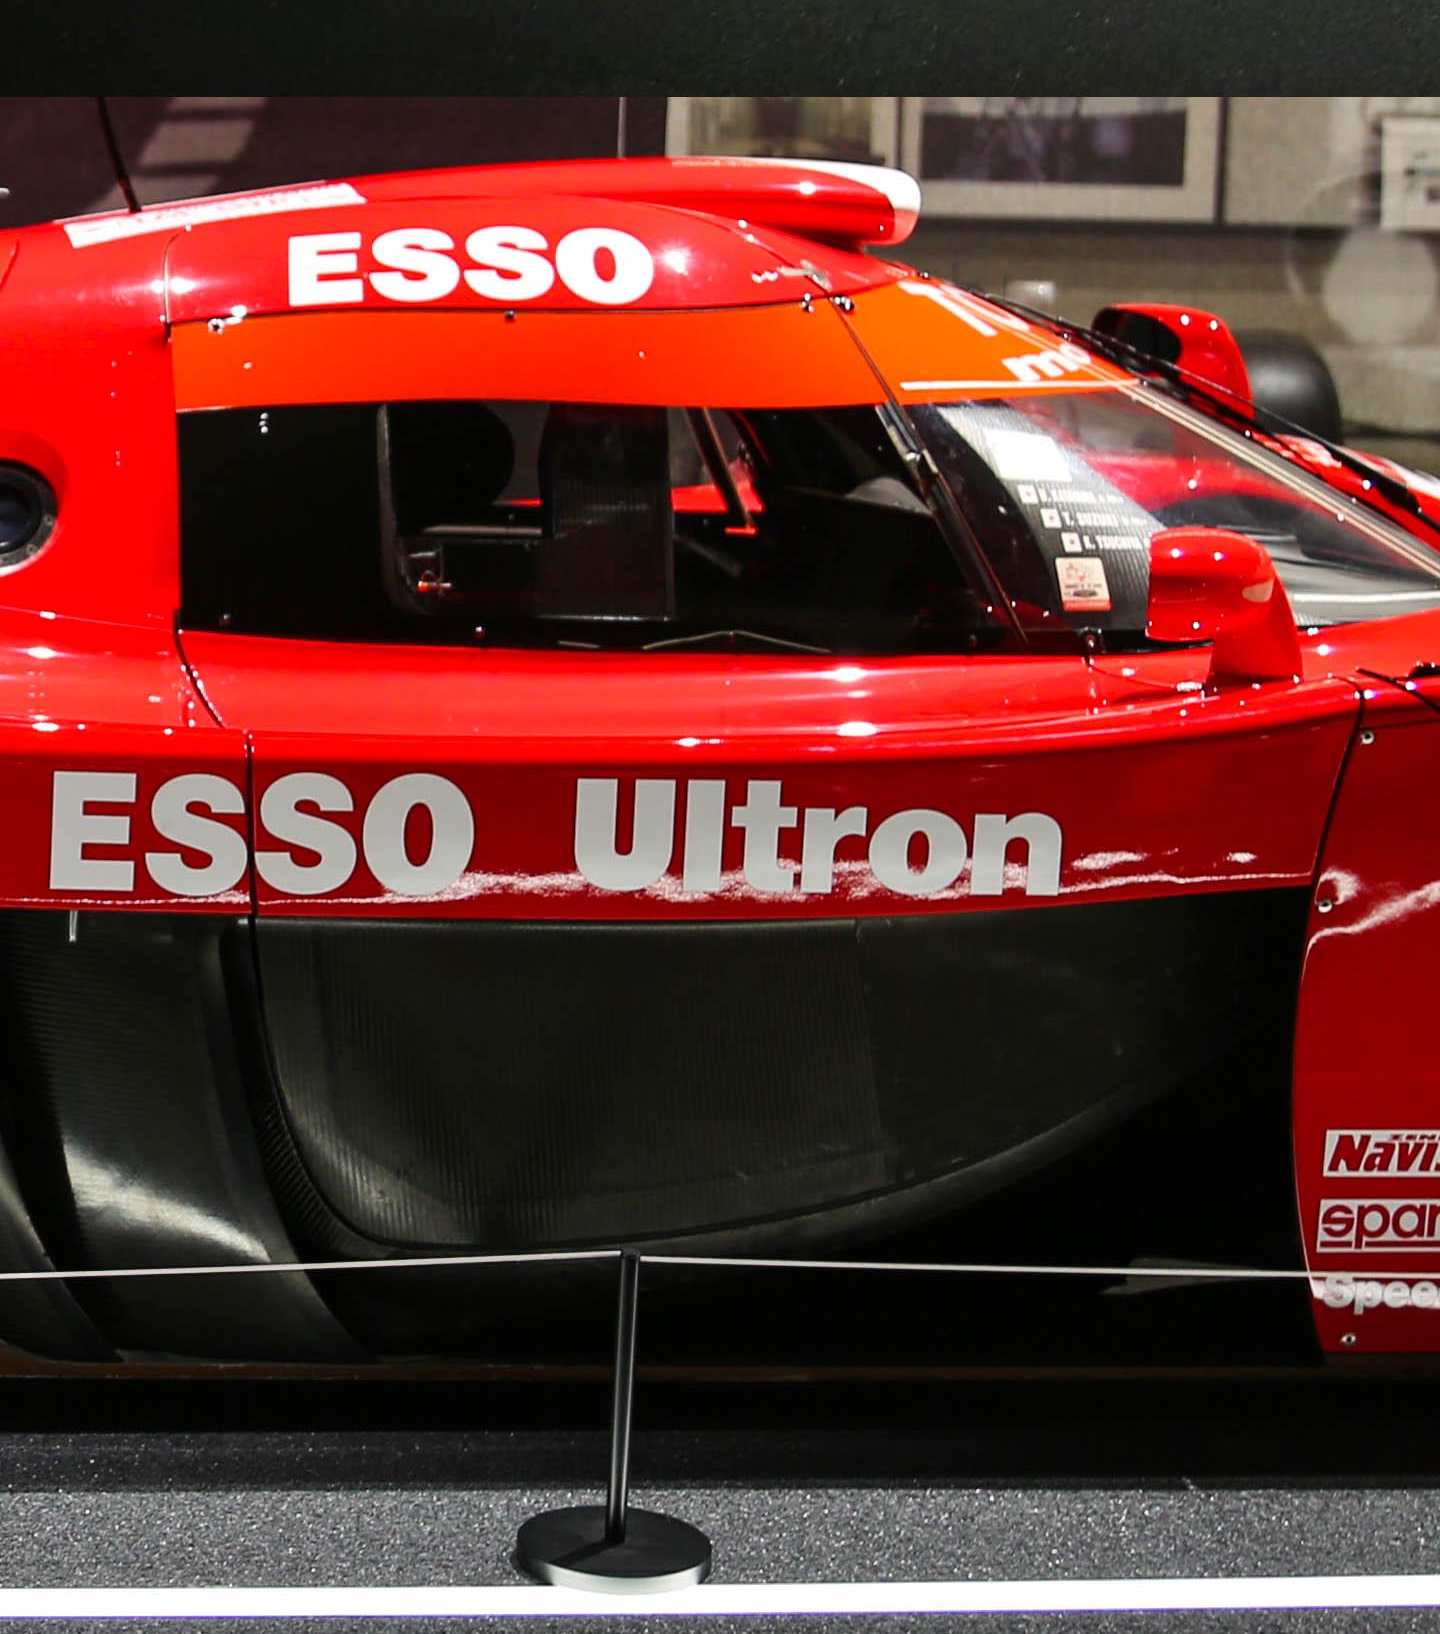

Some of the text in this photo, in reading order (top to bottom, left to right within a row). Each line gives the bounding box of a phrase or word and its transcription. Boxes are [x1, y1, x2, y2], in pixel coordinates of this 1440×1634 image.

[287, 226, 656, 308] ESSO
[50, 772, 1065, 896] ESSO Ultron
